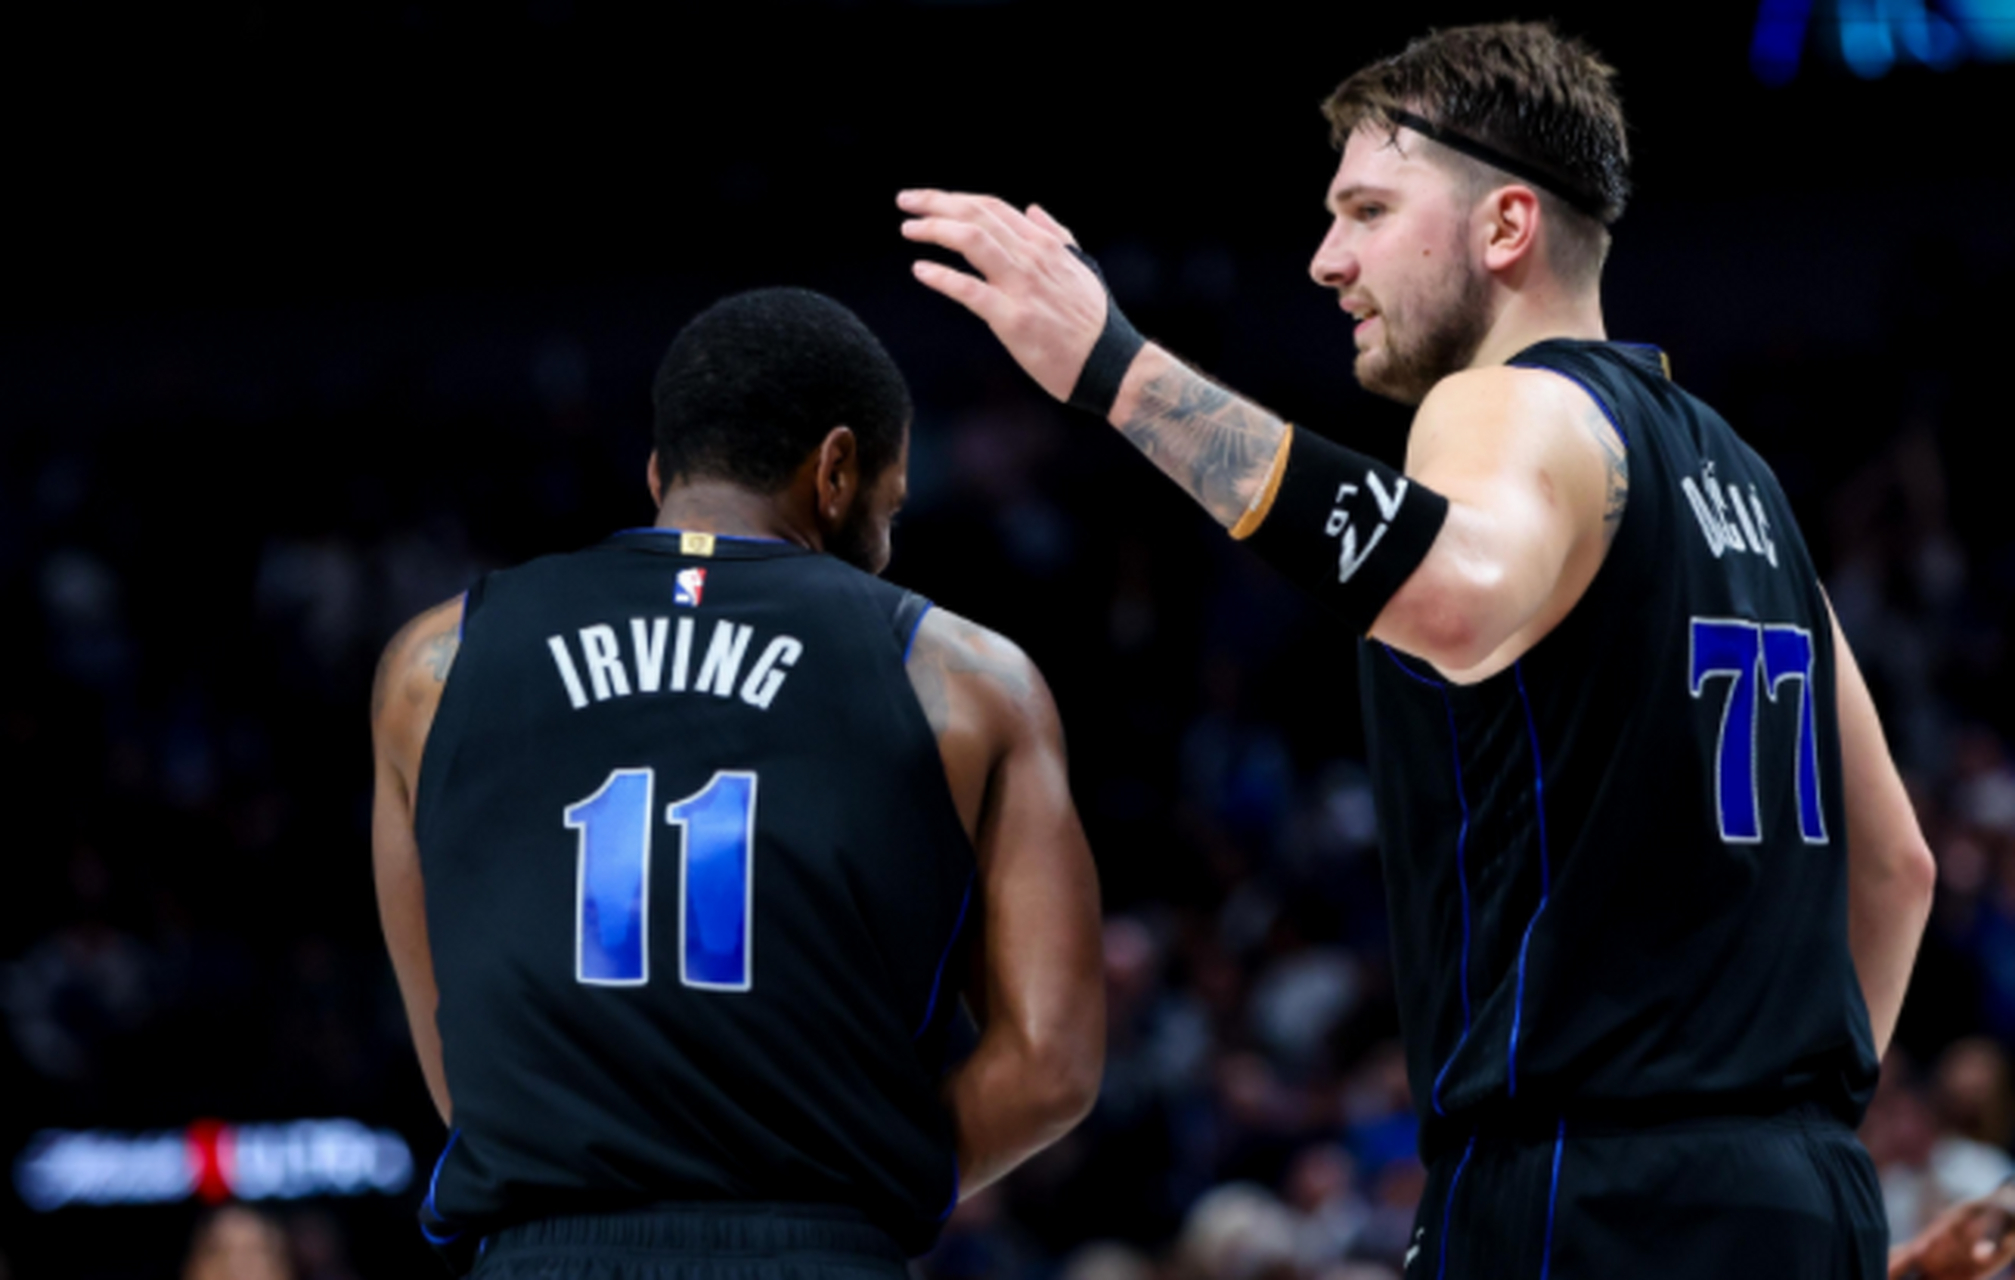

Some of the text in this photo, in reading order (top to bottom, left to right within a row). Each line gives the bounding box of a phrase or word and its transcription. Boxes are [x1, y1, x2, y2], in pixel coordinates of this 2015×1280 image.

[548, 616, 803, 709] IRVING
[1689, 615, 1829, 844] 77
[564, 767, 758, 991] 11
